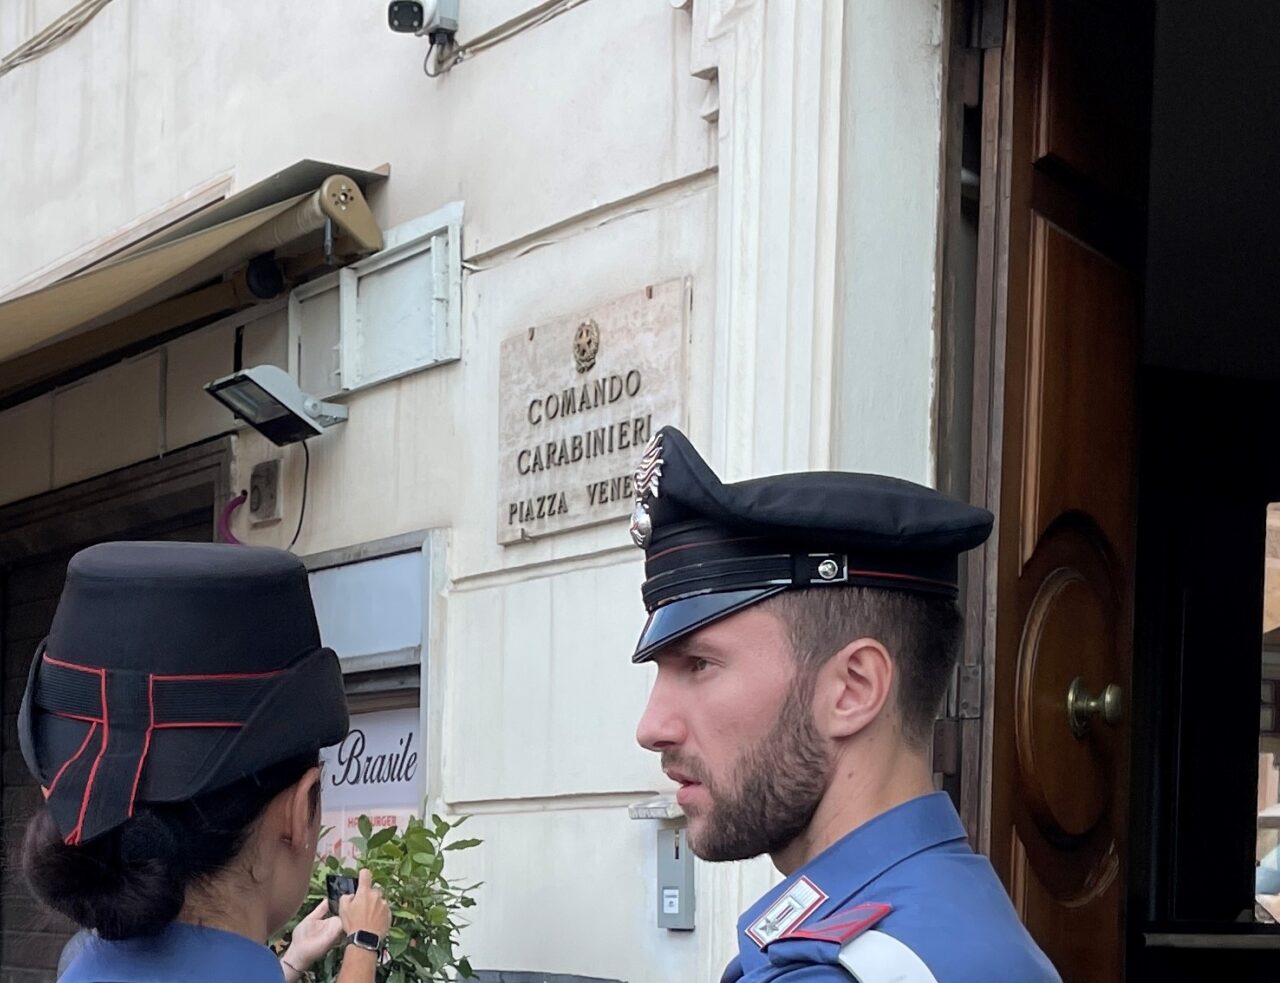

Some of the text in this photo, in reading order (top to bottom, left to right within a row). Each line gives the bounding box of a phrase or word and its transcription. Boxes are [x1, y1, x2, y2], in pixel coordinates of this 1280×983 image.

[527, 369, 642, 426] COMANDO
[517, 414, 652, 476] CARABINIERI
[508, 475, 634, 525] PIAZZA VENE
[332, 729, 418, 786] Brasile
[347, 815, 397, 828] HAURGER
